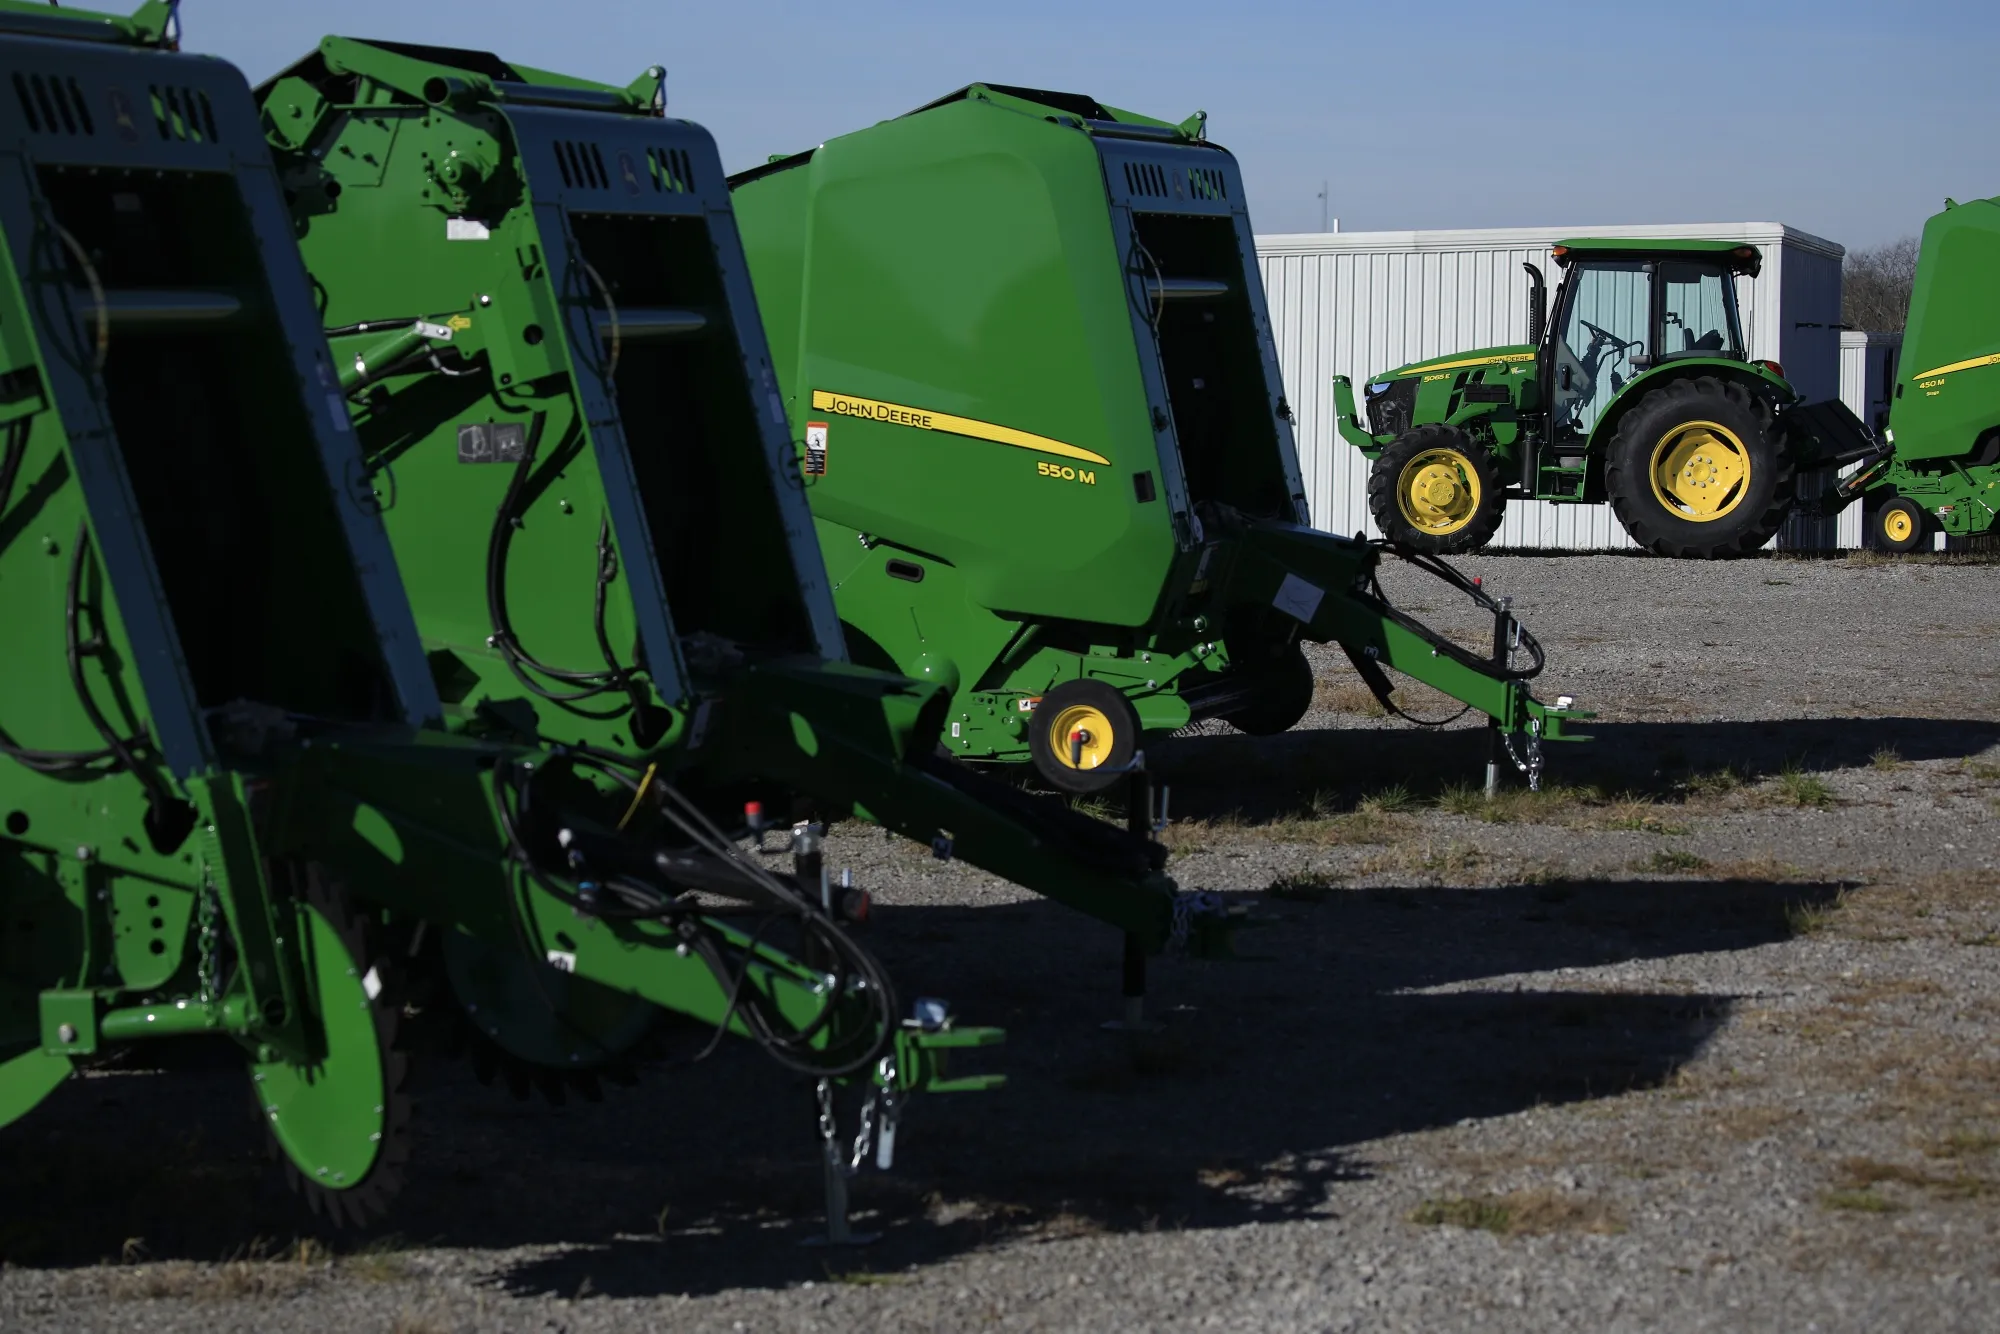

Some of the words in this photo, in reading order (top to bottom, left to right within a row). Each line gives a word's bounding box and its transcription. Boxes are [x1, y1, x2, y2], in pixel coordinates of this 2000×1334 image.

[1919, 380, 1936, 389] 450
[1937, 378, 1945, 386] M
[826, 397, 872, 417] JOHN
[876, 404, 932, 427] DEERE
[1037, 461, 1076, 481] 550
[1078, 469, 1096, 485] M
